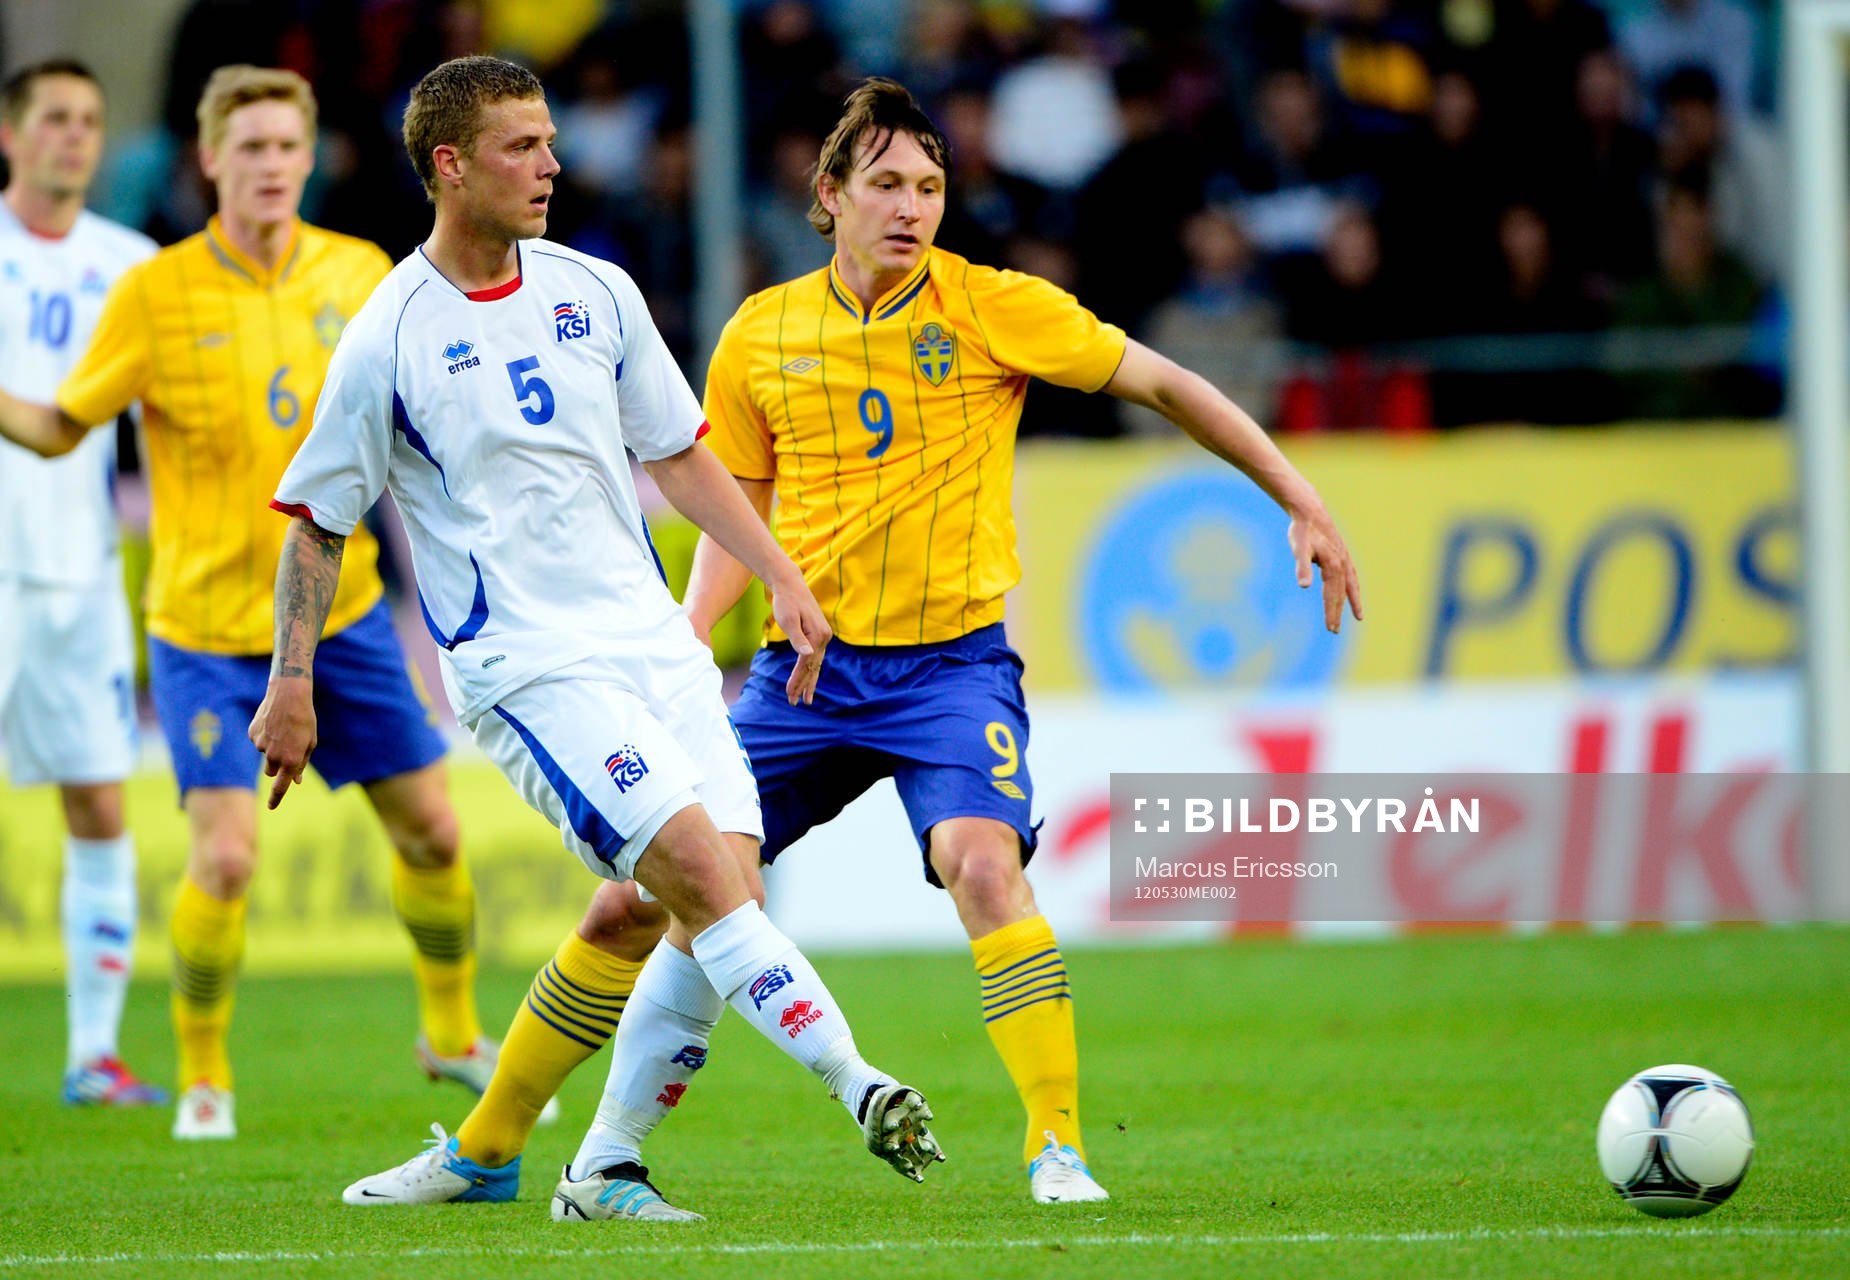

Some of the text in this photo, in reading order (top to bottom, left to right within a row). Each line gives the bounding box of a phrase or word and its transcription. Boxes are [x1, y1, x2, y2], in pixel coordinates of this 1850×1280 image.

[29, 289, 73, 349] 10
[447, 355, 481, 375] errea
[506, 355, 555, 425] 5
[267, 366, 300, 428] 6
[858, 388, 894, 458] 9
[984, 721, 1019, 778] 9
[787, 1008, 824, 1039] errea
